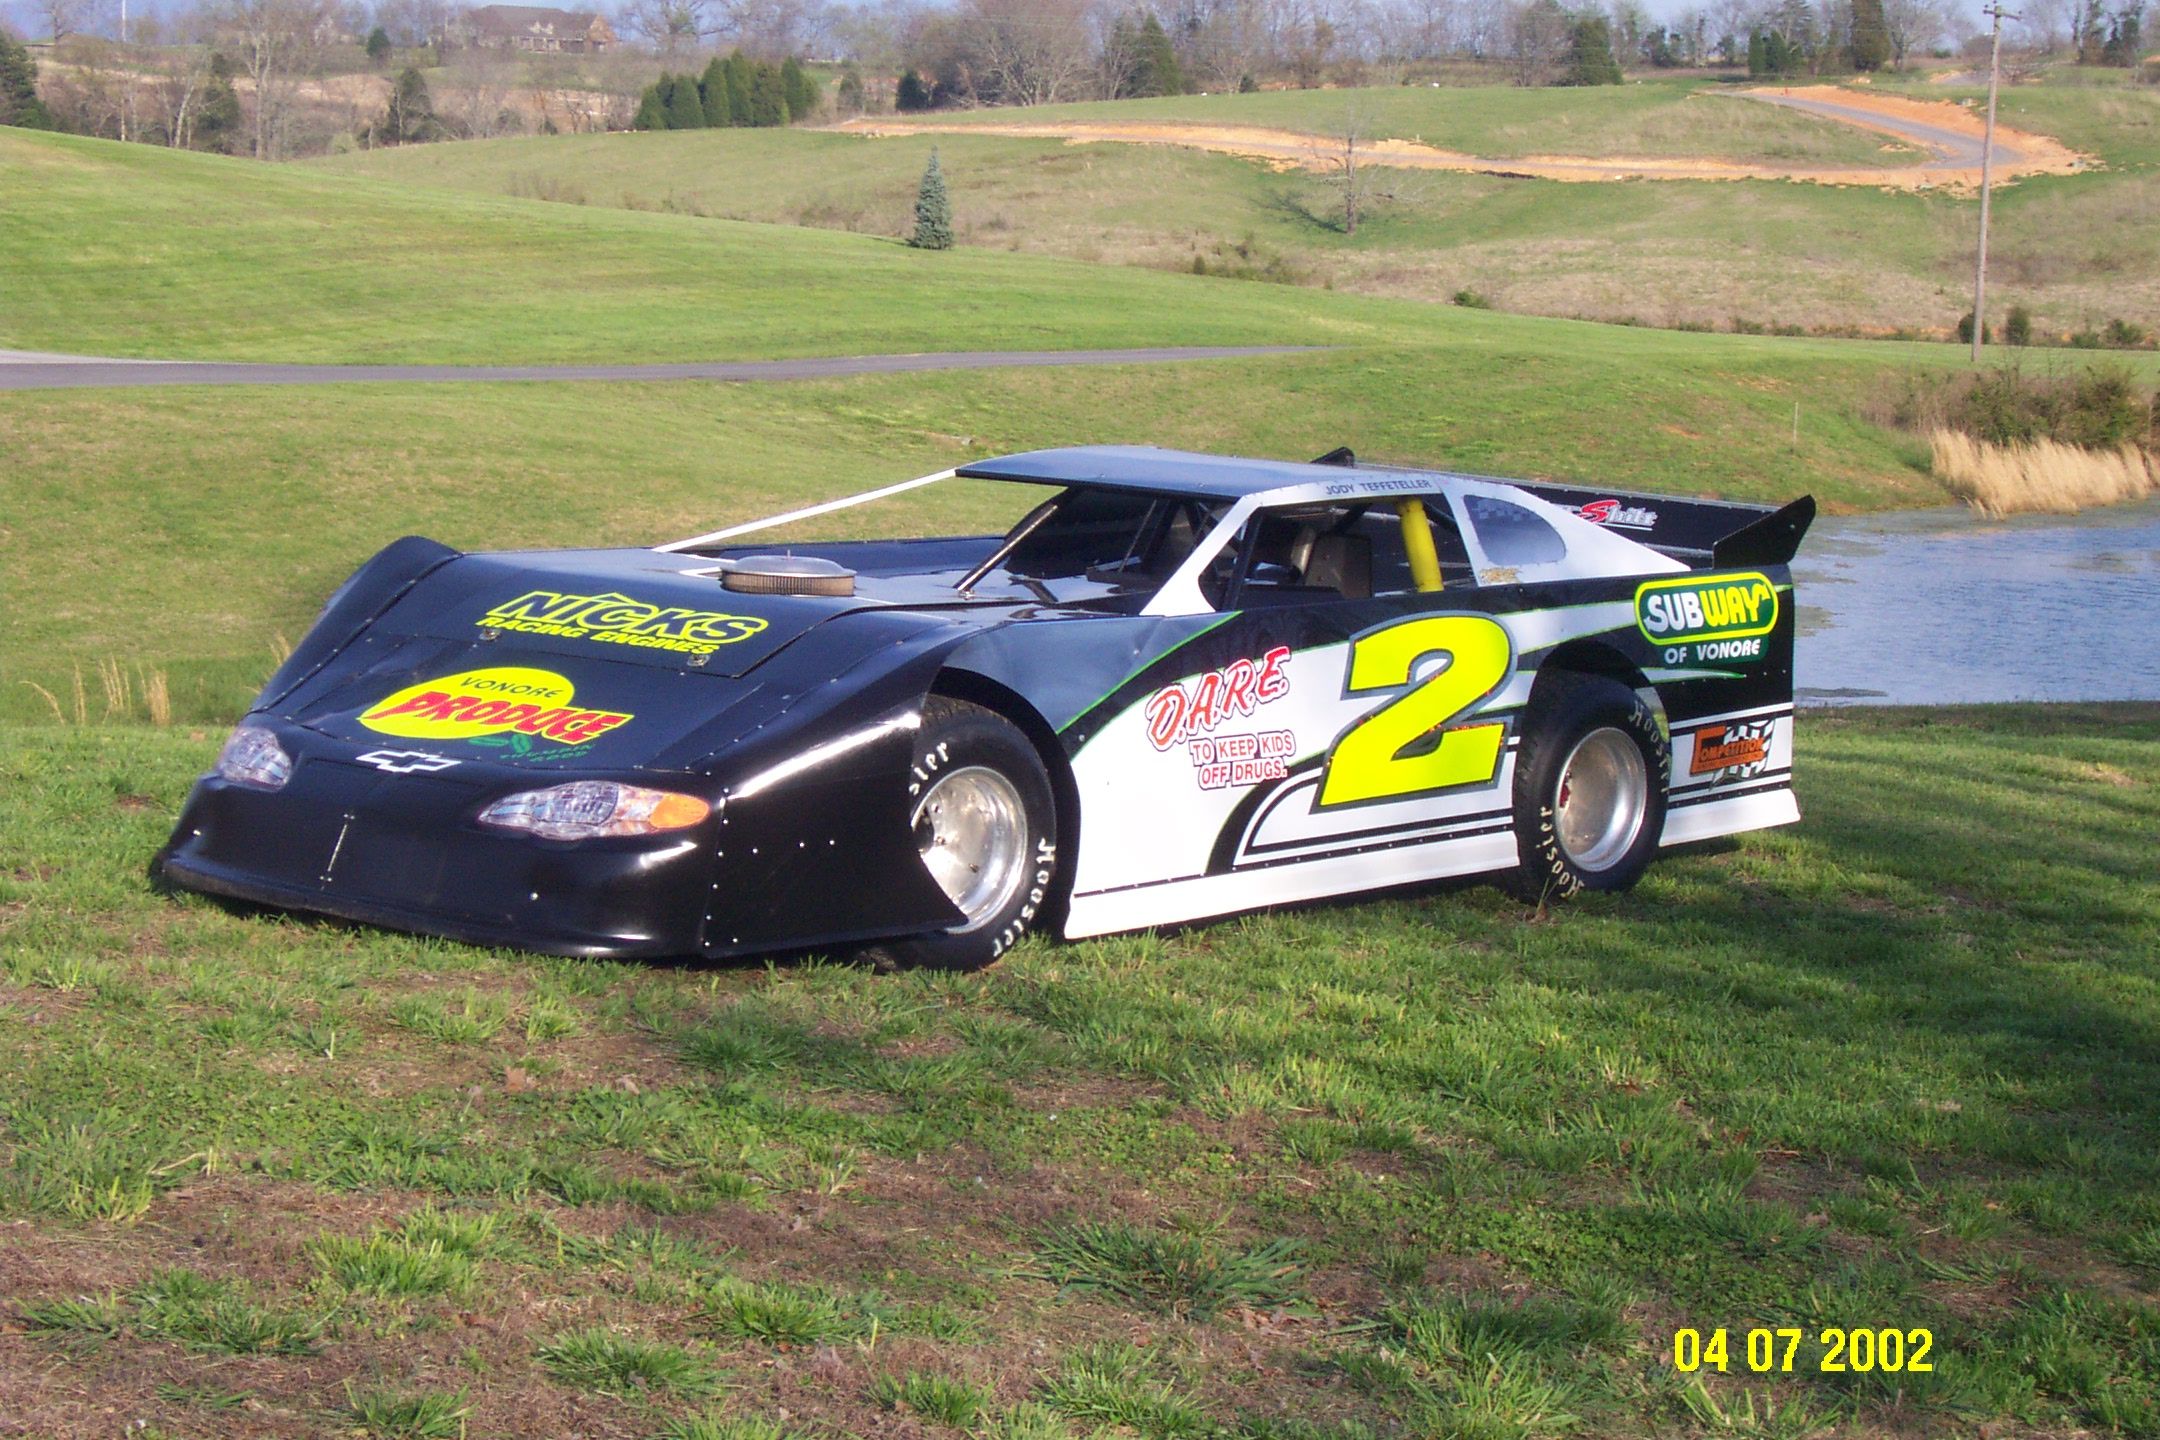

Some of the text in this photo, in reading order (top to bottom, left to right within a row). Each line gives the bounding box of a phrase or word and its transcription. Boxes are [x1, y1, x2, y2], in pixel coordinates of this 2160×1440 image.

[1325, 478, 1433, 496] JODY TEFFETELLER
[485, 590, 770, 645] NICKS
[1643, 582, 1771, 633] SUBWAY
[474, 616, 721, 655] RACING ENGINES
[1663, 638, 1762, 664] OF VONORE
[459, 676, 564, 699] VONORE
[362, 690, 635, 746] PRODUCE
[1314, 612, 1515, 810] 2
[1191, 733, 1294, 761] TO KEEP KIDS
[1200, 758, 1289, 786] OFF DRUGS.
